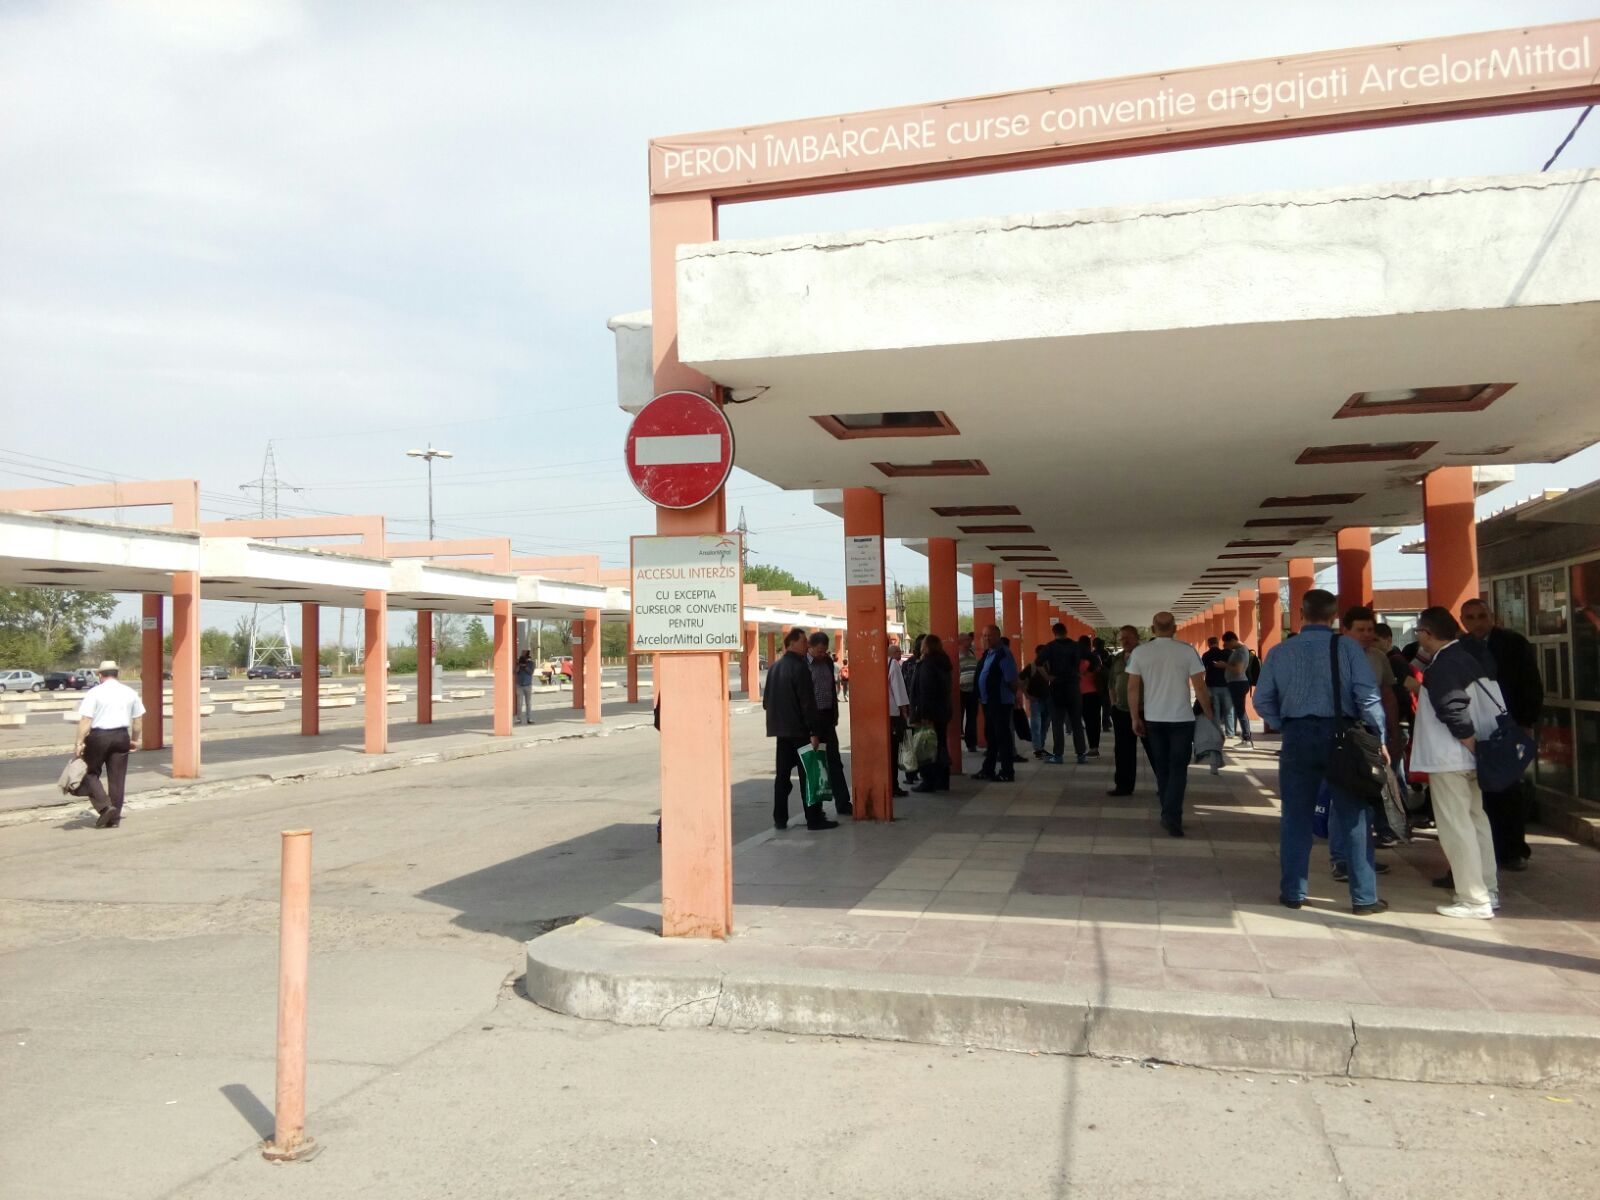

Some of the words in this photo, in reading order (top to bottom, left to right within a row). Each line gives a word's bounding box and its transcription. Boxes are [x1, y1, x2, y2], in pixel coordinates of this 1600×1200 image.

[664, 142, 757, 179] PERON
[765, 118, 936, 168] ÎMBARCARE
[947, 115, 1029, 146] curse
[1041, 87, 1196, 134] convenție
[1207, 67, 1348, 115] angajați
[1359, 35, 1591, 95] ArcelorMittal
[637, 568, 686, 580] ACCESUL
[689, 566, 735, 579] INTERZIS
[656, 590, 669, 600] CU
[674, 589, 717, 600] EXCEPTIA
[635, 604, 681, 615] CURSELOR
[686, 603, 737, 614] CONVENTIE
[669, 618, 704, 628] PENTRU
[636, 633, 703, 645] ArcelorMittal
[706, 633, 737, 644] Galati
